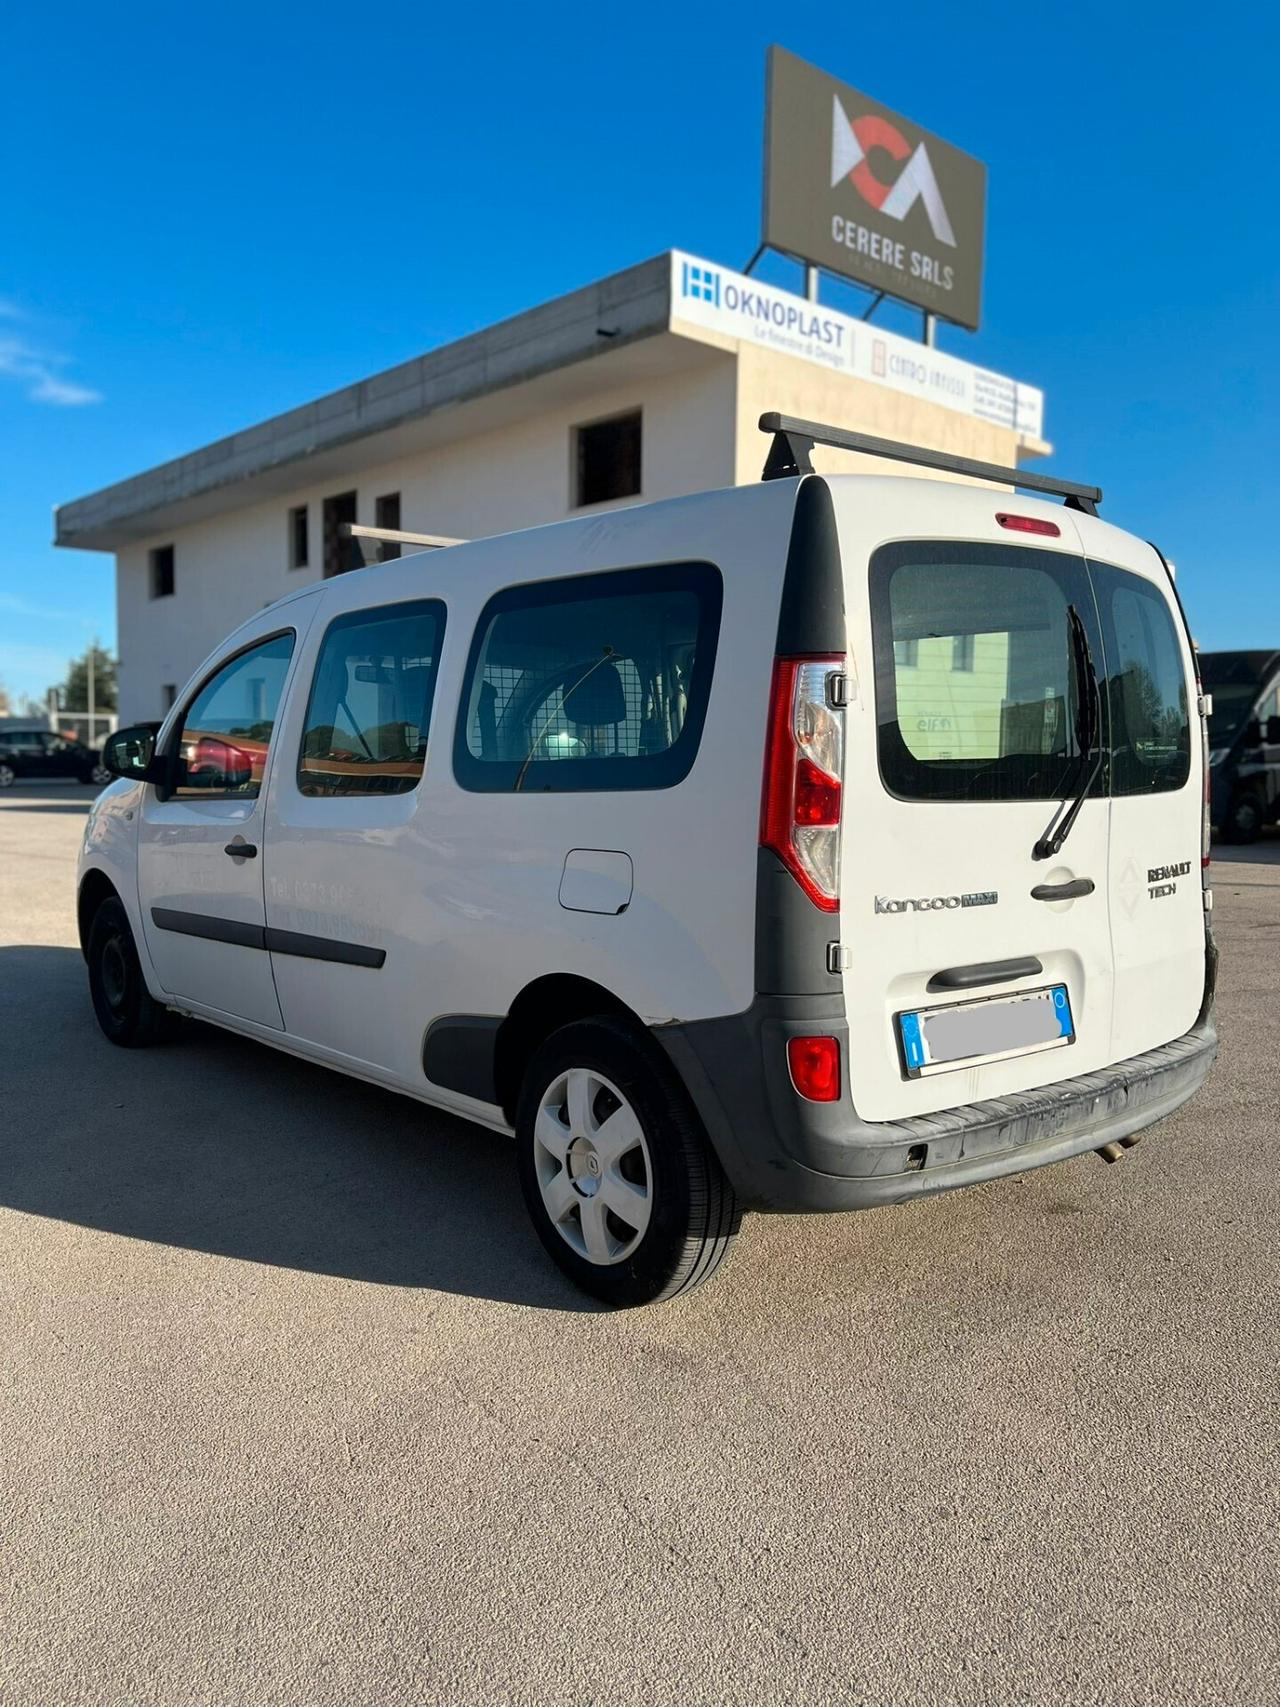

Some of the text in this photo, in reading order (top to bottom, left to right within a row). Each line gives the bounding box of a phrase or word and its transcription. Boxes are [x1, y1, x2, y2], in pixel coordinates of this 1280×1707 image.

[831, 214, 905, 271] CERERE
[910, 250, 954, 291] SRLS
[724, 284, 845, 348] OKNOPLAST
[1147, 861, 1192, 883] RENAULT
[1147, 882, 1177, 899] TECH
